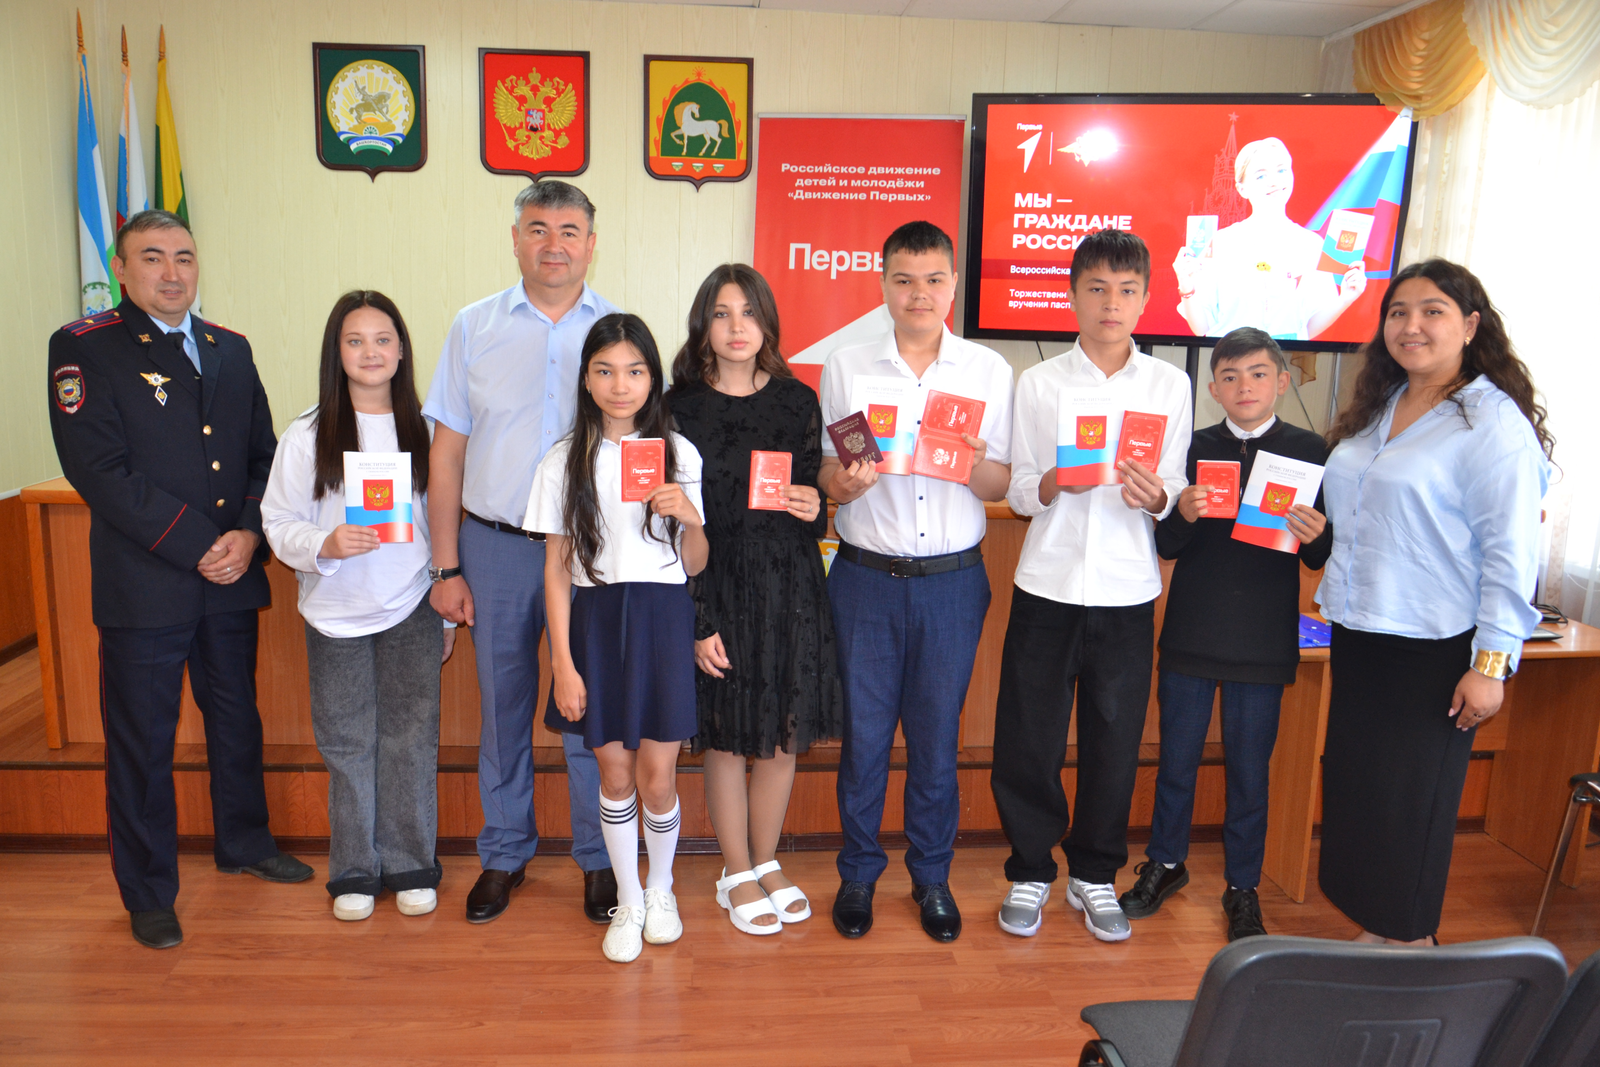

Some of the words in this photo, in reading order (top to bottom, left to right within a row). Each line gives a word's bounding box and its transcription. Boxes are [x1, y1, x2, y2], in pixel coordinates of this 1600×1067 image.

[781, 163, 866, 174] Российское
[868, 165, 941, 176] движение
[795, 176, 836, 188] детей
[839, 179, 848, 187] и
[850, 178, 925, 189] молодёжи
[788, 189, 867, 201] «Движение
[869, 191, 931, 203] Первых»
[1014, 192, 1052, 208] МЫ
[1013, 213, 1132, 232] ГРАЖДАНЕ
[1012, 234, 1086, 250] РОССИ
[1010, 265, 1071, 275] Всероссийска
[1009, 289, 1068, 299] Торжественн
[1008, 300, 1049, 309] вручения
[1050, 301, 1072, 309] пасп
[1128, 439, 1152, 448] Первые
